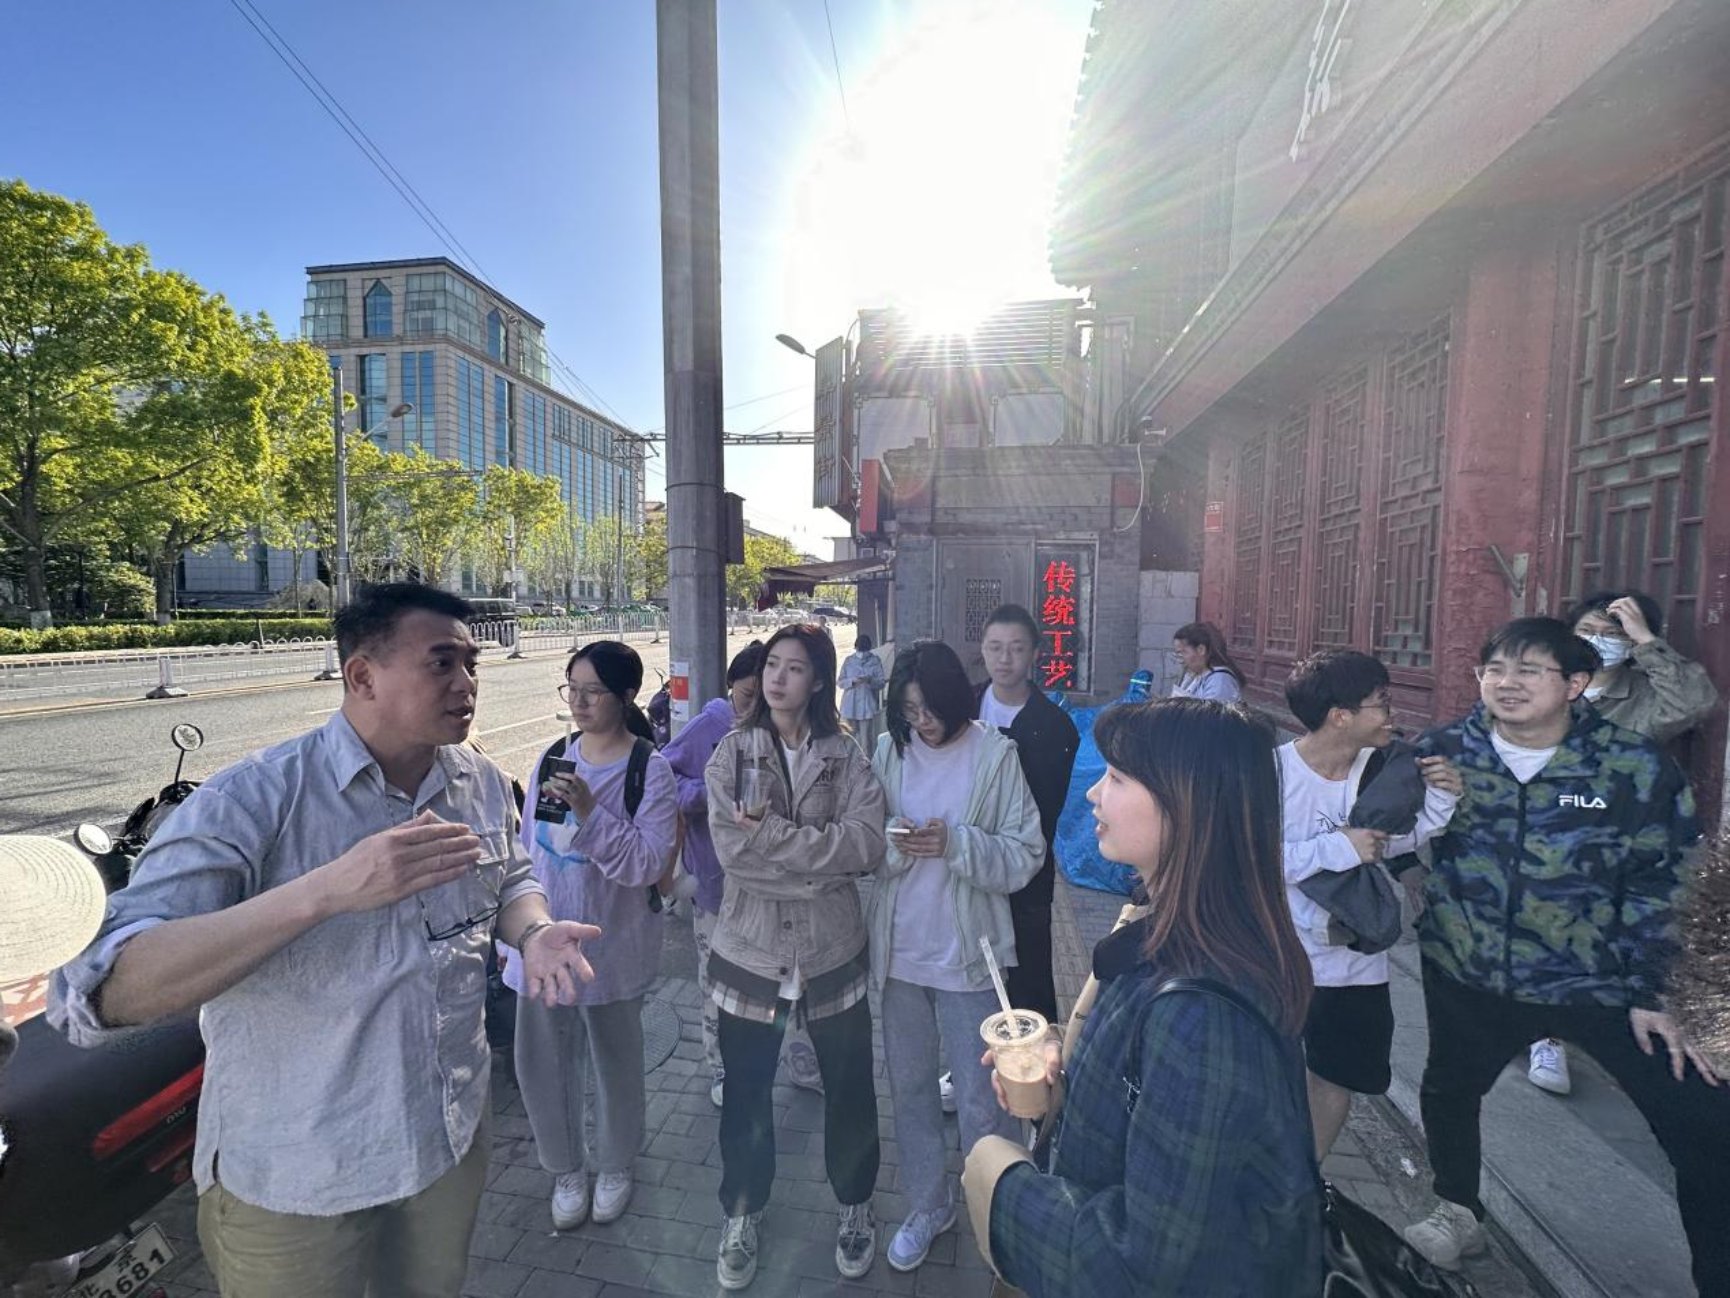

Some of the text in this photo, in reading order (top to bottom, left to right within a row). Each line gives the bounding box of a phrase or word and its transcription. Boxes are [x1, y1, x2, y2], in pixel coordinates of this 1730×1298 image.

[1042, 561, 1075, 688] 传统工艺
[1558, 794, 1607, 810] FILA
